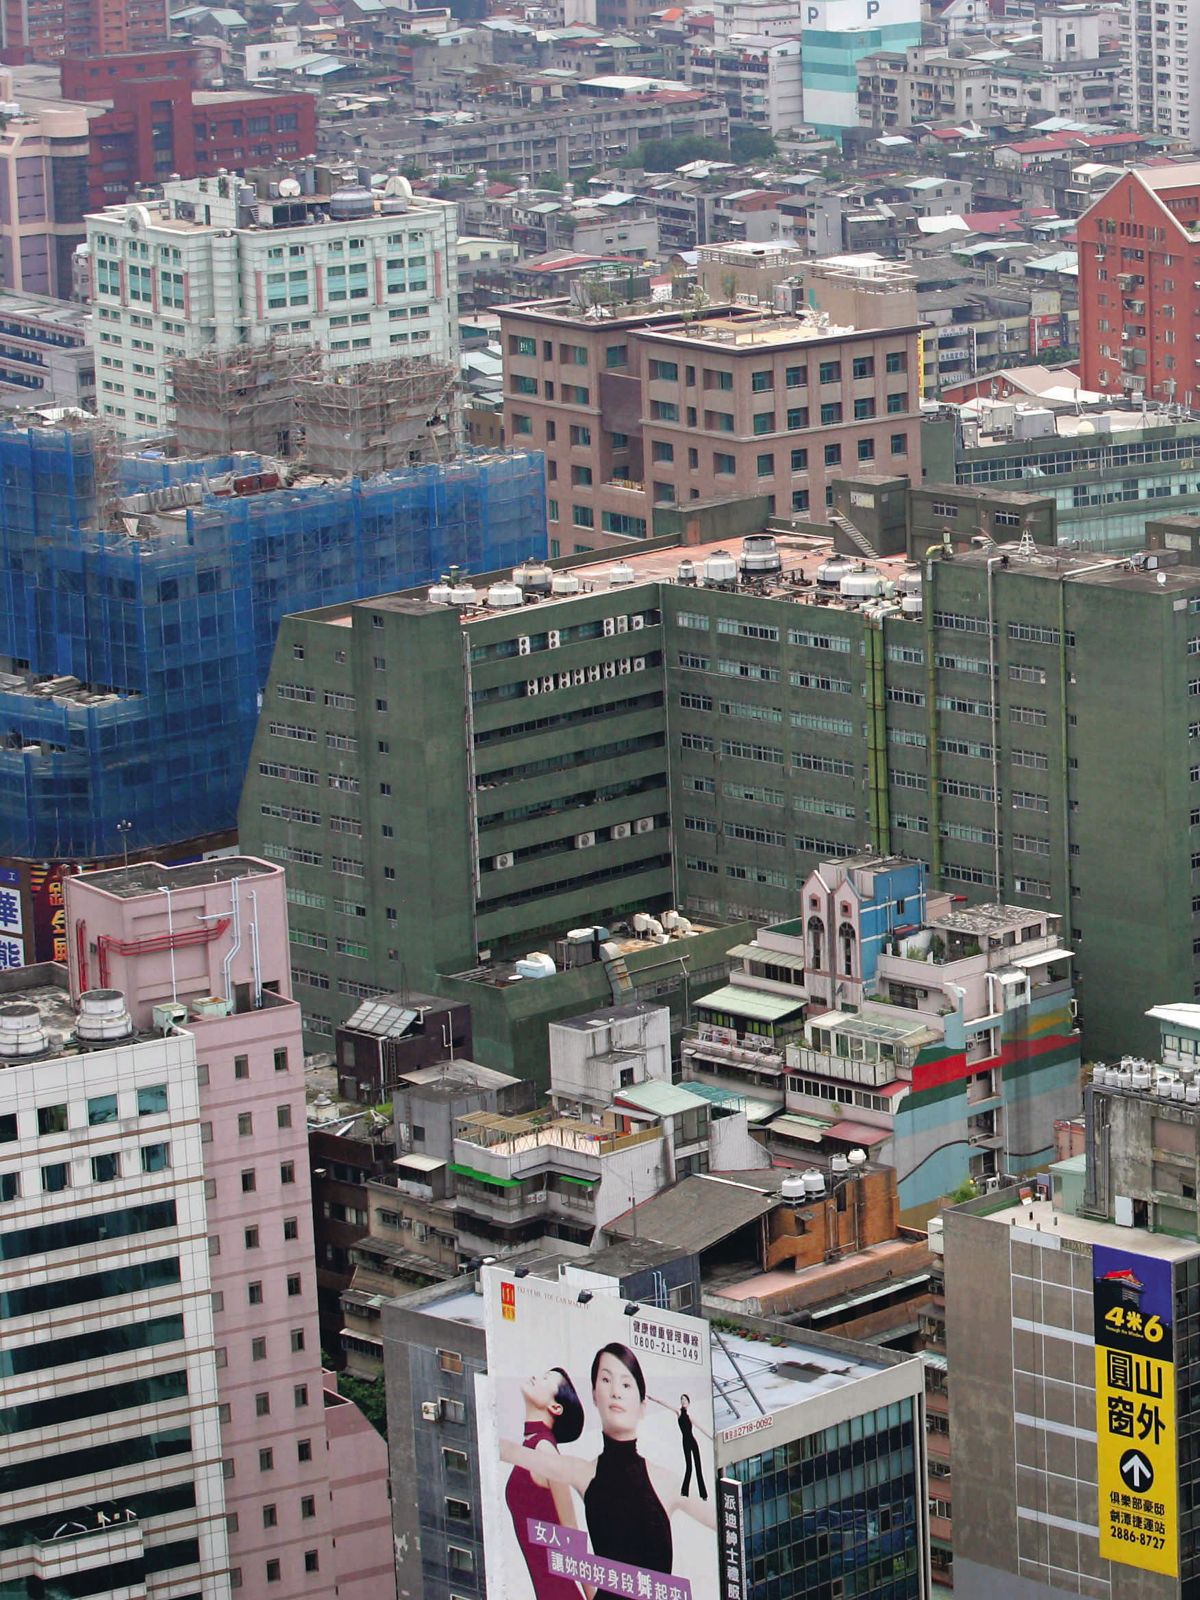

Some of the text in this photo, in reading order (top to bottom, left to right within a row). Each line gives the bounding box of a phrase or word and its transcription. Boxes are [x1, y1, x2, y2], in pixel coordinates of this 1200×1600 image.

[808, 7, 819, 24] P
[867, 1, 879, 19] P
[634, 1335, 698, 1360] 0800-211-049
[1107, 1350, 1163, 1399] 圓山
[1108, 1396, 1166, 1445] 窗外
[1110, 1491, 1165, 1516] 俱樂部豪邸
[1110, 1509, 1165, 1535] 劍潭捷運站
[1110, 1525, 1165, 1550] 2886-8727
